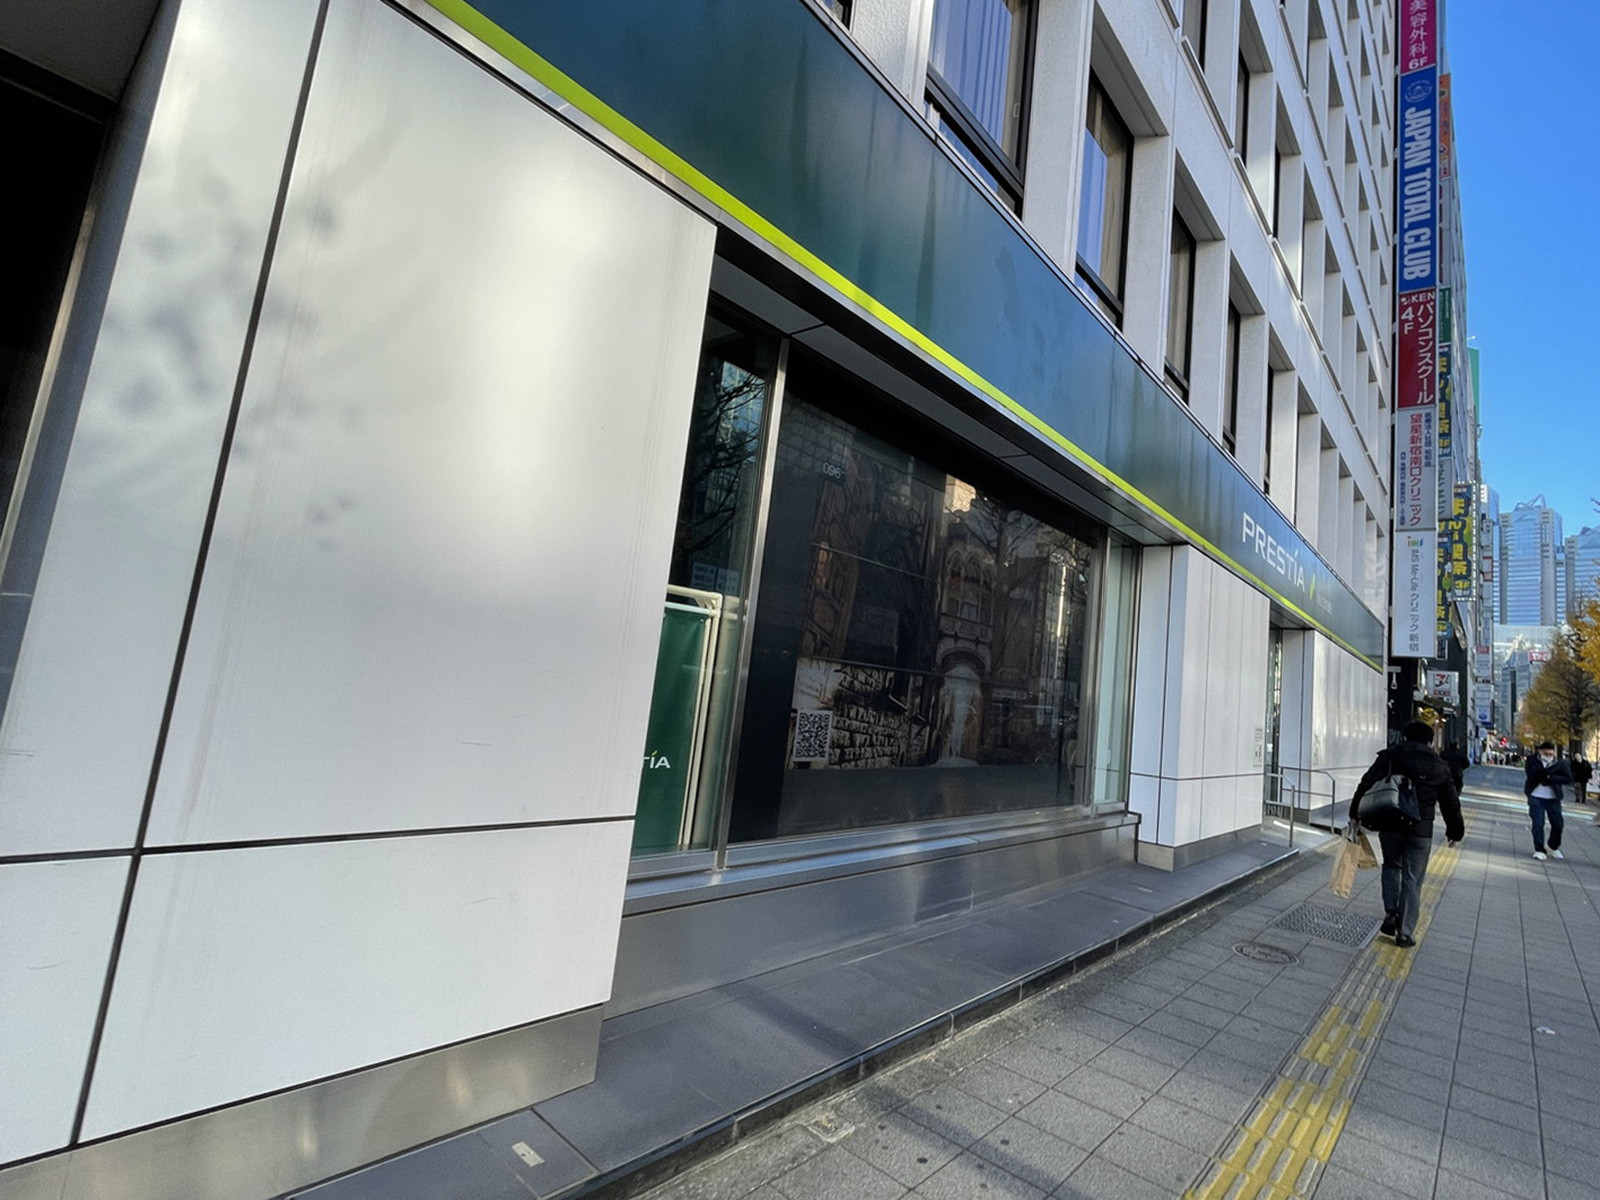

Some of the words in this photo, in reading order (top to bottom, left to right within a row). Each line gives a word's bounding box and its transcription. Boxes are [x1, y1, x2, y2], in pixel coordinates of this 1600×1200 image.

[1408, 56, 1428, 70] 6F
[1404, 106, 1432, 169] JAPAN
[1403, 167, 1432, 229] TOTAL
[1403, 226, 1432, 281] CLUB
[1401, 306, 1415, 335] 4F
[1417, 301, 1434, 404] パソコンスクール
